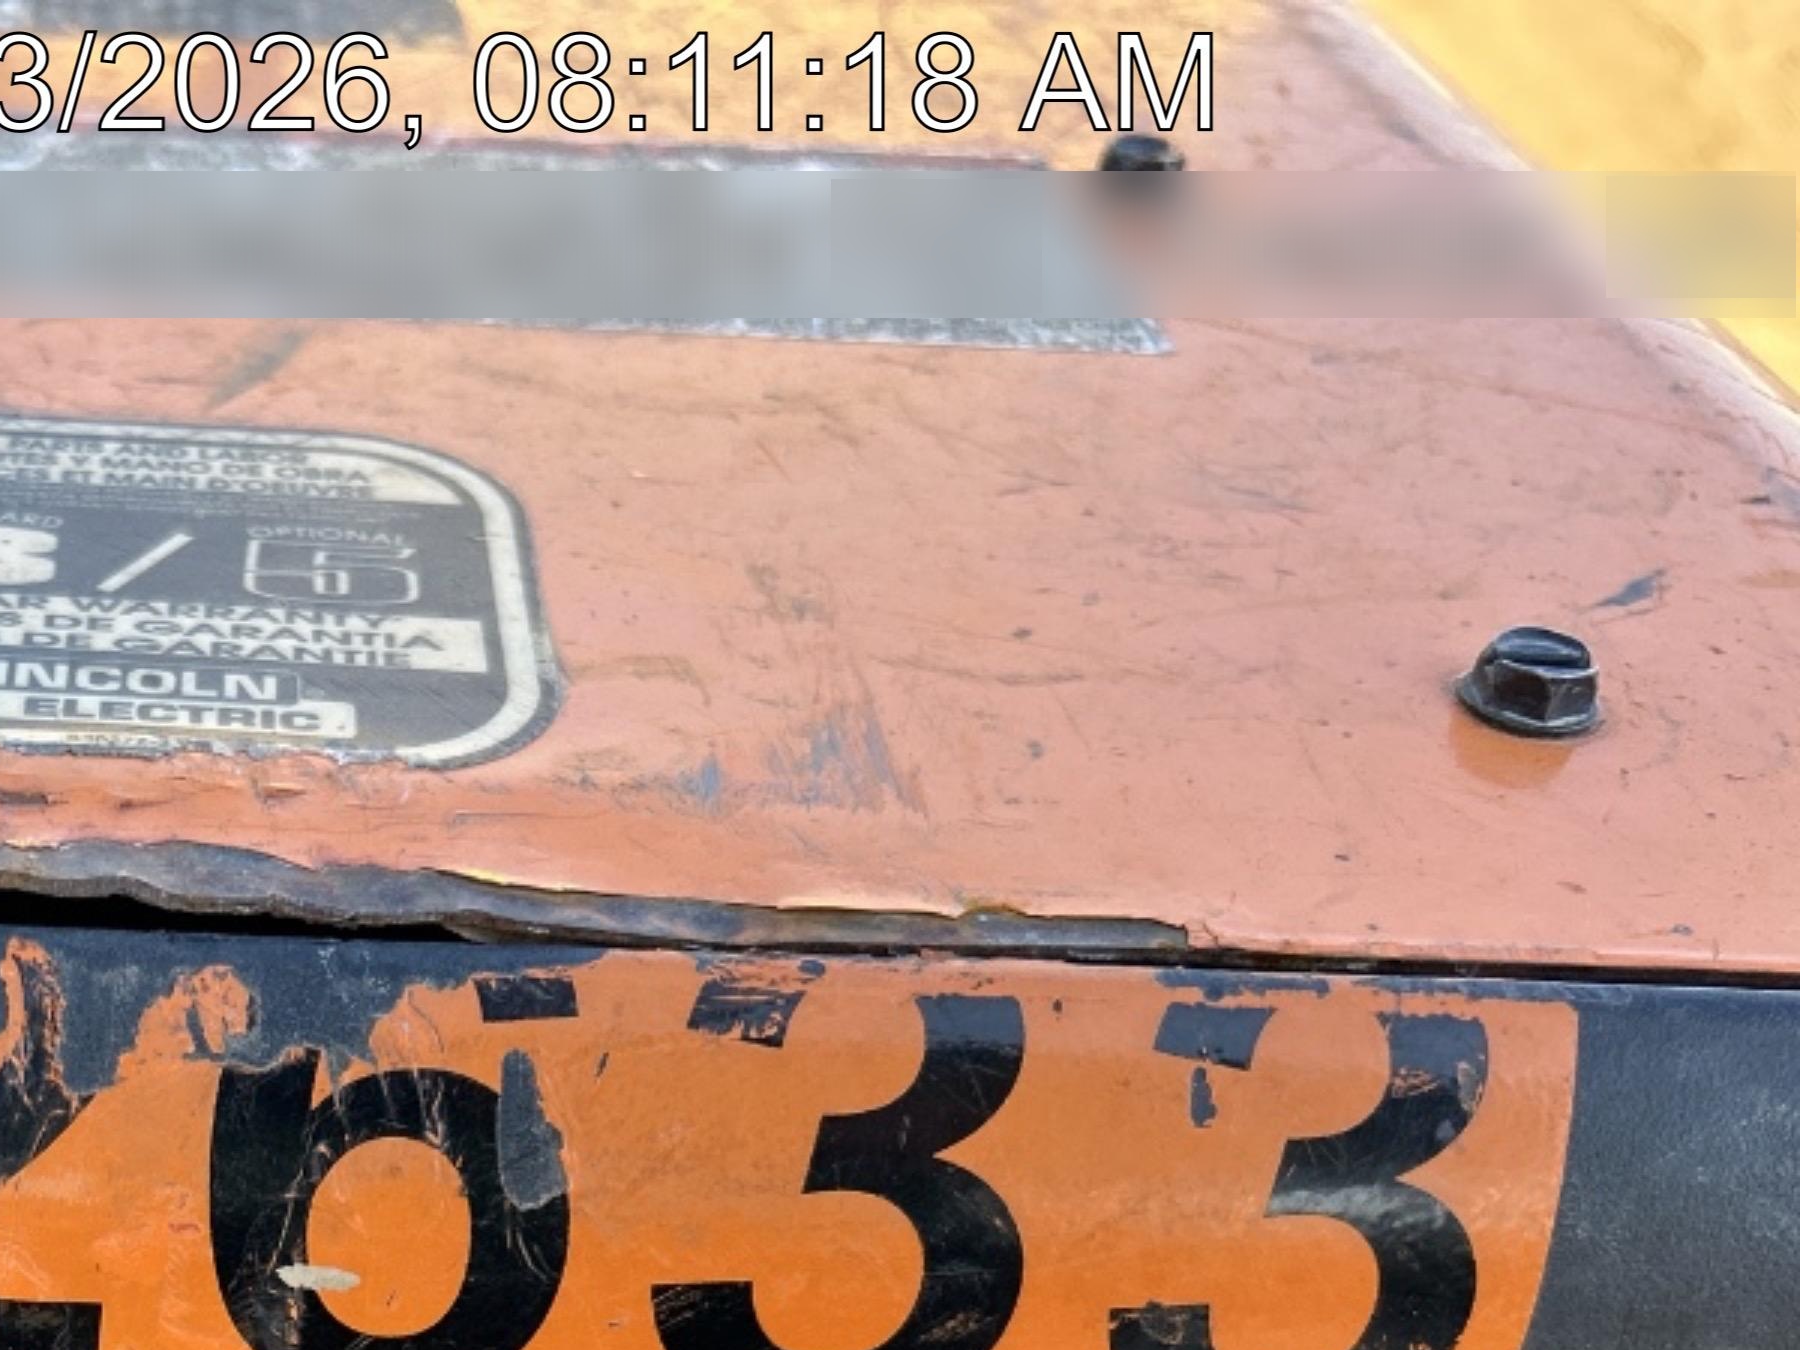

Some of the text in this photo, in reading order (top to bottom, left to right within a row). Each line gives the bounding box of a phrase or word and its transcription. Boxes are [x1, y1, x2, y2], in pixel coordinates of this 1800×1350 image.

[44, 614, 117, 632] DE
[71, 595, 389, 629] WARRANTY
[24, 632, 91, 649] DE
[23, 696, 322, 732] ELECTRIC
